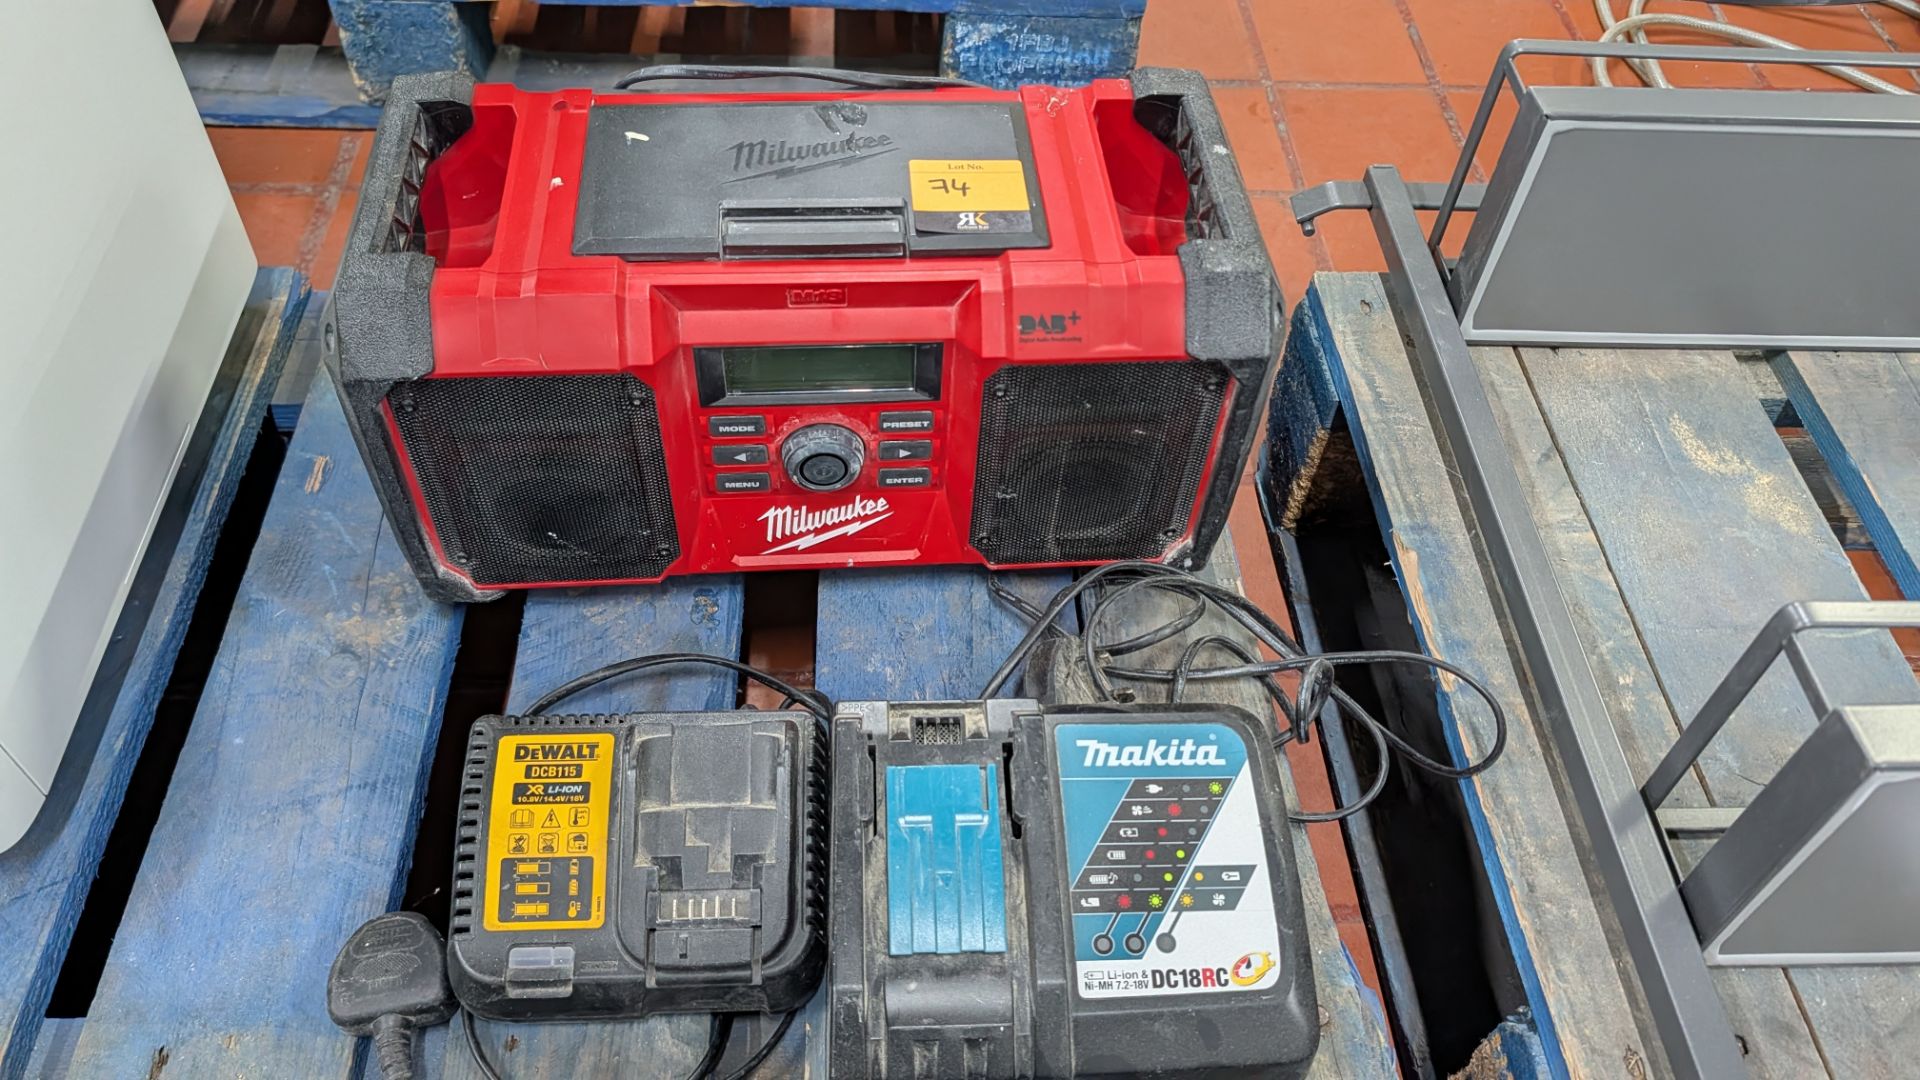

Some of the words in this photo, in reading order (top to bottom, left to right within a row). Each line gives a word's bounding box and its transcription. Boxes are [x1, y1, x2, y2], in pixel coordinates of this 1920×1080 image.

[724, 132, 894, 172] Milwaukee
[928, 178, 971, 197] 74
[718, 425, 756, 433] MODE
[882, 421, 931, 429] PRESET
[724, 481, 760, 489] MENU
[885, 476, 924, 485] ENTER
[757, 495, 889, 542] Milwaukee
[531, 766, 577, 777] DCB115
[526, 784, 545, 795] XR
[547, 785, 583, 793] LI-ION
[1107, 970, 1139, 980] Li-ion
[1141, 970, 1149, 979] &
[1152, 967, 1229, 989] DC18RC
[1085, 981, 1113, 991] Ni-MH
[1116, 979, 1149, 990] 7.2-18V
